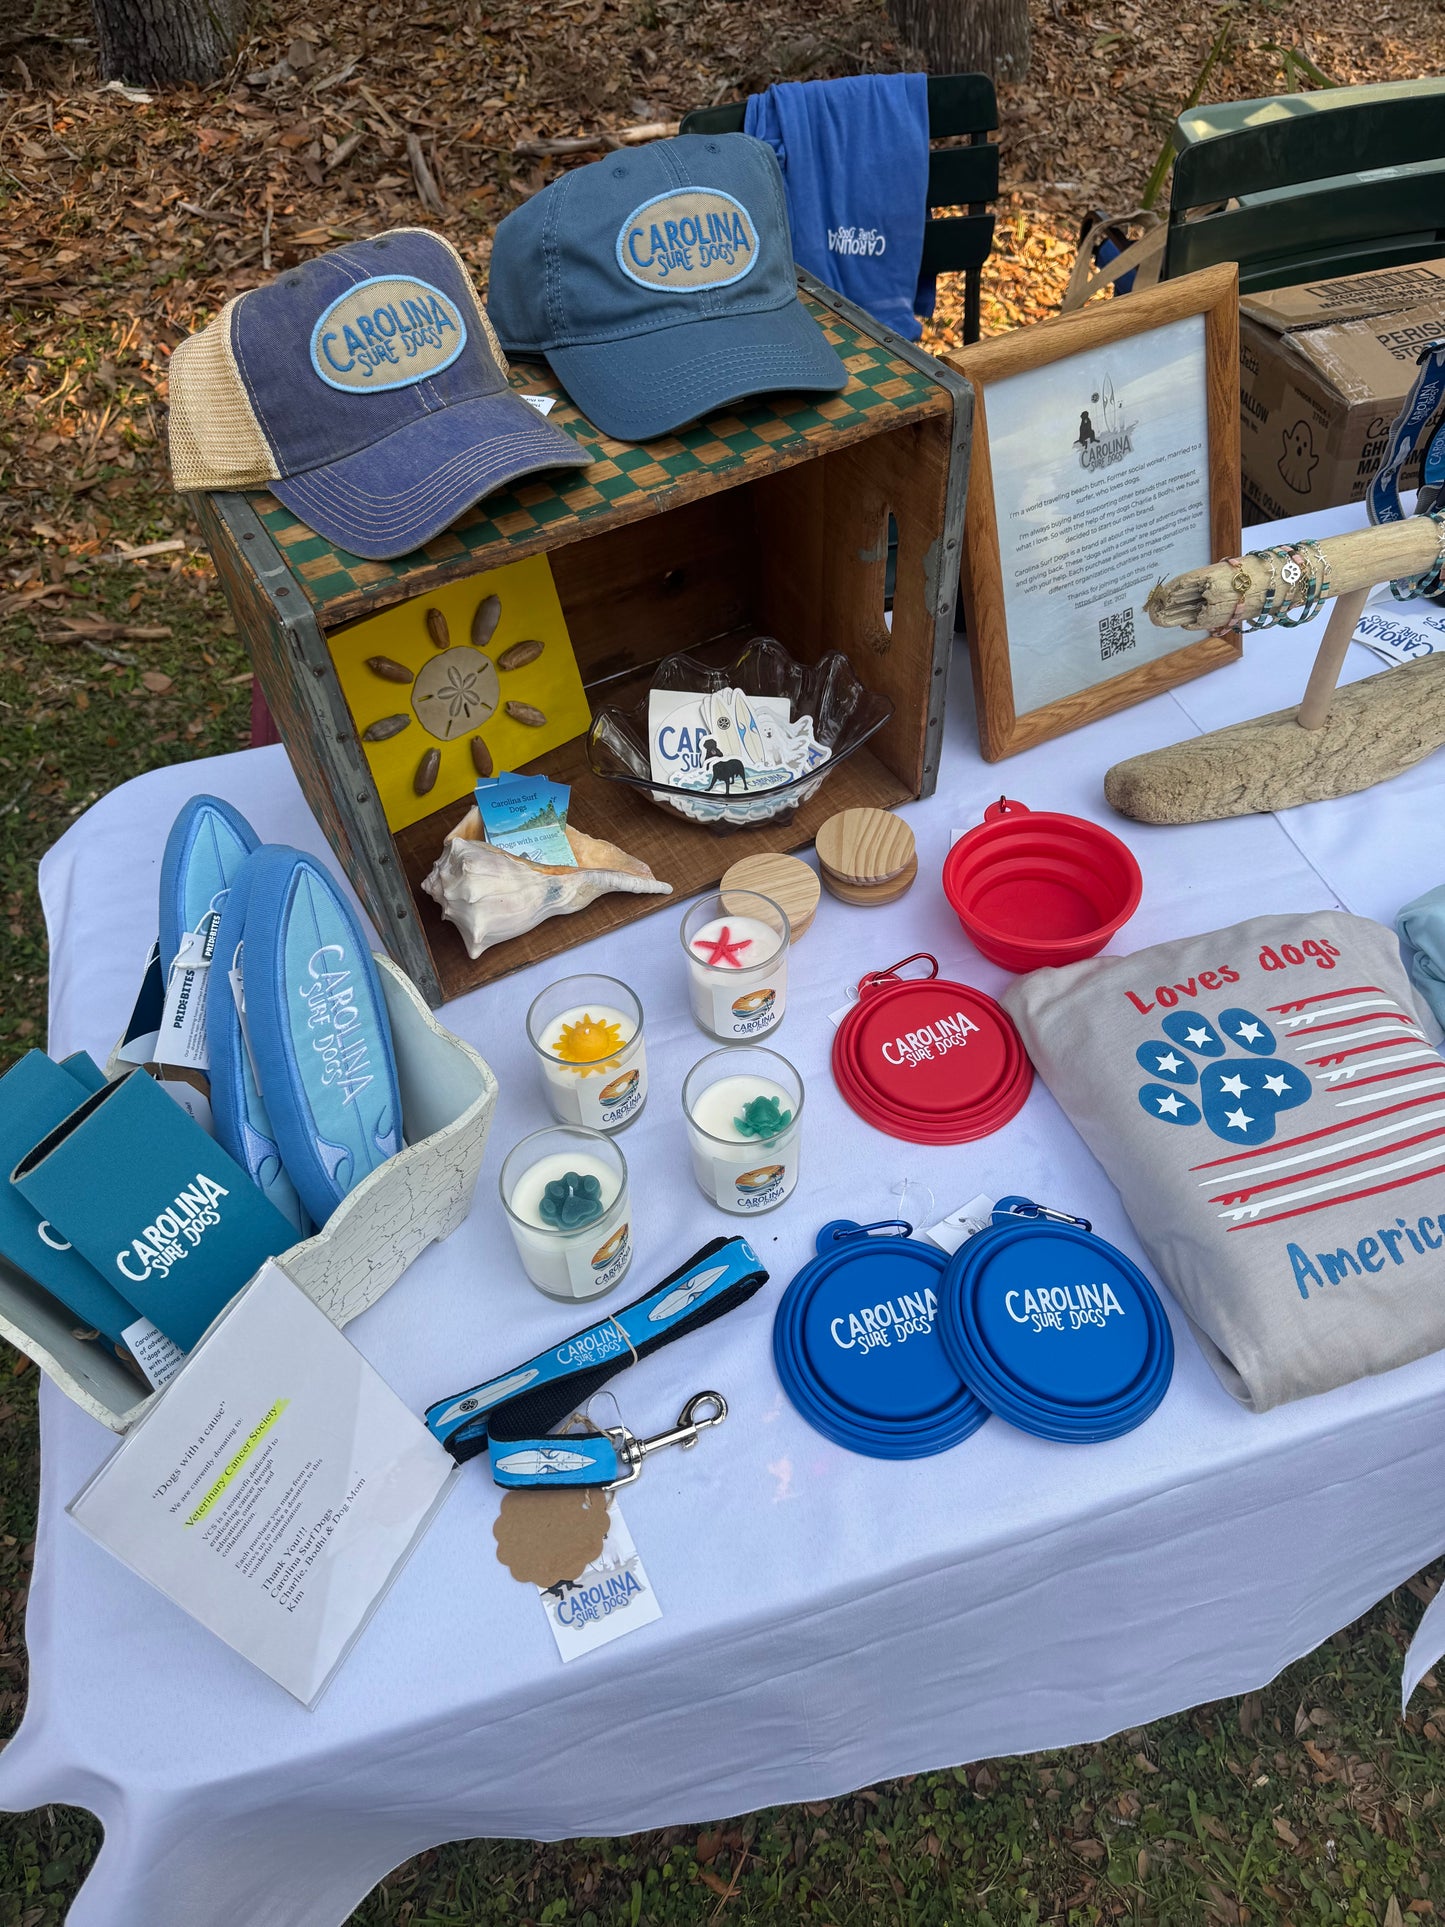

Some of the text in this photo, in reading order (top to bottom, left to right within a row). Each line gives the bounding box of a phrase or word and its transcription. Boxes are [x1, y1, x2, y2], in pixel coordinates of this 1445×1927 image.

[629, 212, 751, 268] CAROLINA
[658, 243, 736, 277] SURF DOGS
[828, 229, 886, 257] CAROLINA
[322, 295, 457, 373] CAROLINA
[358, 326, 443, 378] SURF DOGS
[1081, 435, 1132, 469] CAROLINA
[1107, 452, 1124, 468] DOGS
[1025, 500, 1043, 513] world
[1043, 491, 1070, 506] traveling
[1070, 484, 1089, 496] beach
[1106, 469, 1127, 483] Former
[1128, 462, 1145, 474] social
[1167, 445, 1190, 459] married
[1095, 487, 1109, 497] who
[1109, 481, 1124, 492] loves
[1029, 523, 1050, 536] always
[1050, 515, 1072, 528] buying
[1072, 509, 1085, 520] and
[1085, 498, 1118, 516] supporting
[1117, 491, 1134, 502] other
[1134, 484, 1155, 496] brands
[1155, 479, 1167, 488] that
[1167, 468, 1196, 484] represent
[1064, 529, 1090, 543] decided
[1097, 521, 1112, 532] start
[1111, 517, 1122, 526] our
[1122, 512, 1135, 521] own
[1067, 589, 1089, 600] Thanks
[1089, 585, 1098, 593] for
[1098, 577, 1119, 591] joining
[1134, 566, 1146, 574] this
[1367, 614, 1429, 643] SURF DOGS
[491, 793, 538, 809] Carolina Surf
[509, 805, 528, 814] Dogs
[517, 837, 534, 846] with
[1124, 935, 1341, 1016] Loves dogs
[299, 982, 343, 1086] SURF DOGS
[308, 944, 375, 1106] CAROLINA
[733, 1012, 776, 1033] CAROLINA
[881, 1011, 980, 1066] CAROLINA
[906, 1032, 968, 1068] SURF DOGS
[602, 1092, 642, 1122] CAROLINA
[737, 1187, 785, 1207] CAROLINA
[116, 1173, 230, 1282] CAROLINA
[150, 1204, 221, 1279] SURF DOGS
[1004, 1283, 1125, 1323] CAROLINA
[1031, 1308, 1107, 1334] SURF DOGS
[556, 1322, 631, 1365] CAROLINA
[574, 1340, 621, 1367] SURF DOGS
[857, 1315, 932, 1355] SURF DOGS
[148, 1359, 163, 1371] with
[162, 1349, 176, 1362] your
[153, 1356, 181, 1378] donations
[168, 1417, 243, 1513] We are currently donating to:
[179, 1444, 199, 1466] with
[184, 1405, 277, 1525] Veterinary Cancer Society
[201, 1523, 217, 1540] VCS
[215, 1516, 223, 1524] is
[226, 1478, 250, 1510] nonprofit
[249, 1445, 272, 1478] dedicated
[271, 1438, 278, 1446] to
[209, 1459, 274, 1547] eradicating cancer through
[215, 1470, 275, 1552] education, outreach, and
[234, 1461, 312, 1569] Each purchase you make from us
[242, 1551, 259, 1574] allows
[258, 1541, 266, 1550] us
[264, 1533, 271, 1541] to
[270, 1514, 285, 1533] make
[287, 1479, 308, 1508] donation
[306, 1471, 313, 1479] to
[312, 1458, 323, 1470] this
[222, 1512, 257, 1557] collaboration.
[247, 1501, 303, 1578] wonderful organization.
[270, 1508, 333, 1598] Carolina Surf Dogs
[278, 1569, 308, 1605] Charlie,
[304, 1535, 327, 1566] Bodhi
[331, 1503, 350, 1524] Dog
[346, 1478, 366, 1503] Mom
[260, 1526, 307, 1590] Thank You!!!
[286, 1590, 304, 1612] Kim
[557, 1571, 642, 1625] CAROLINA
[576, 1592, 630, 1628] SURF DOGS
